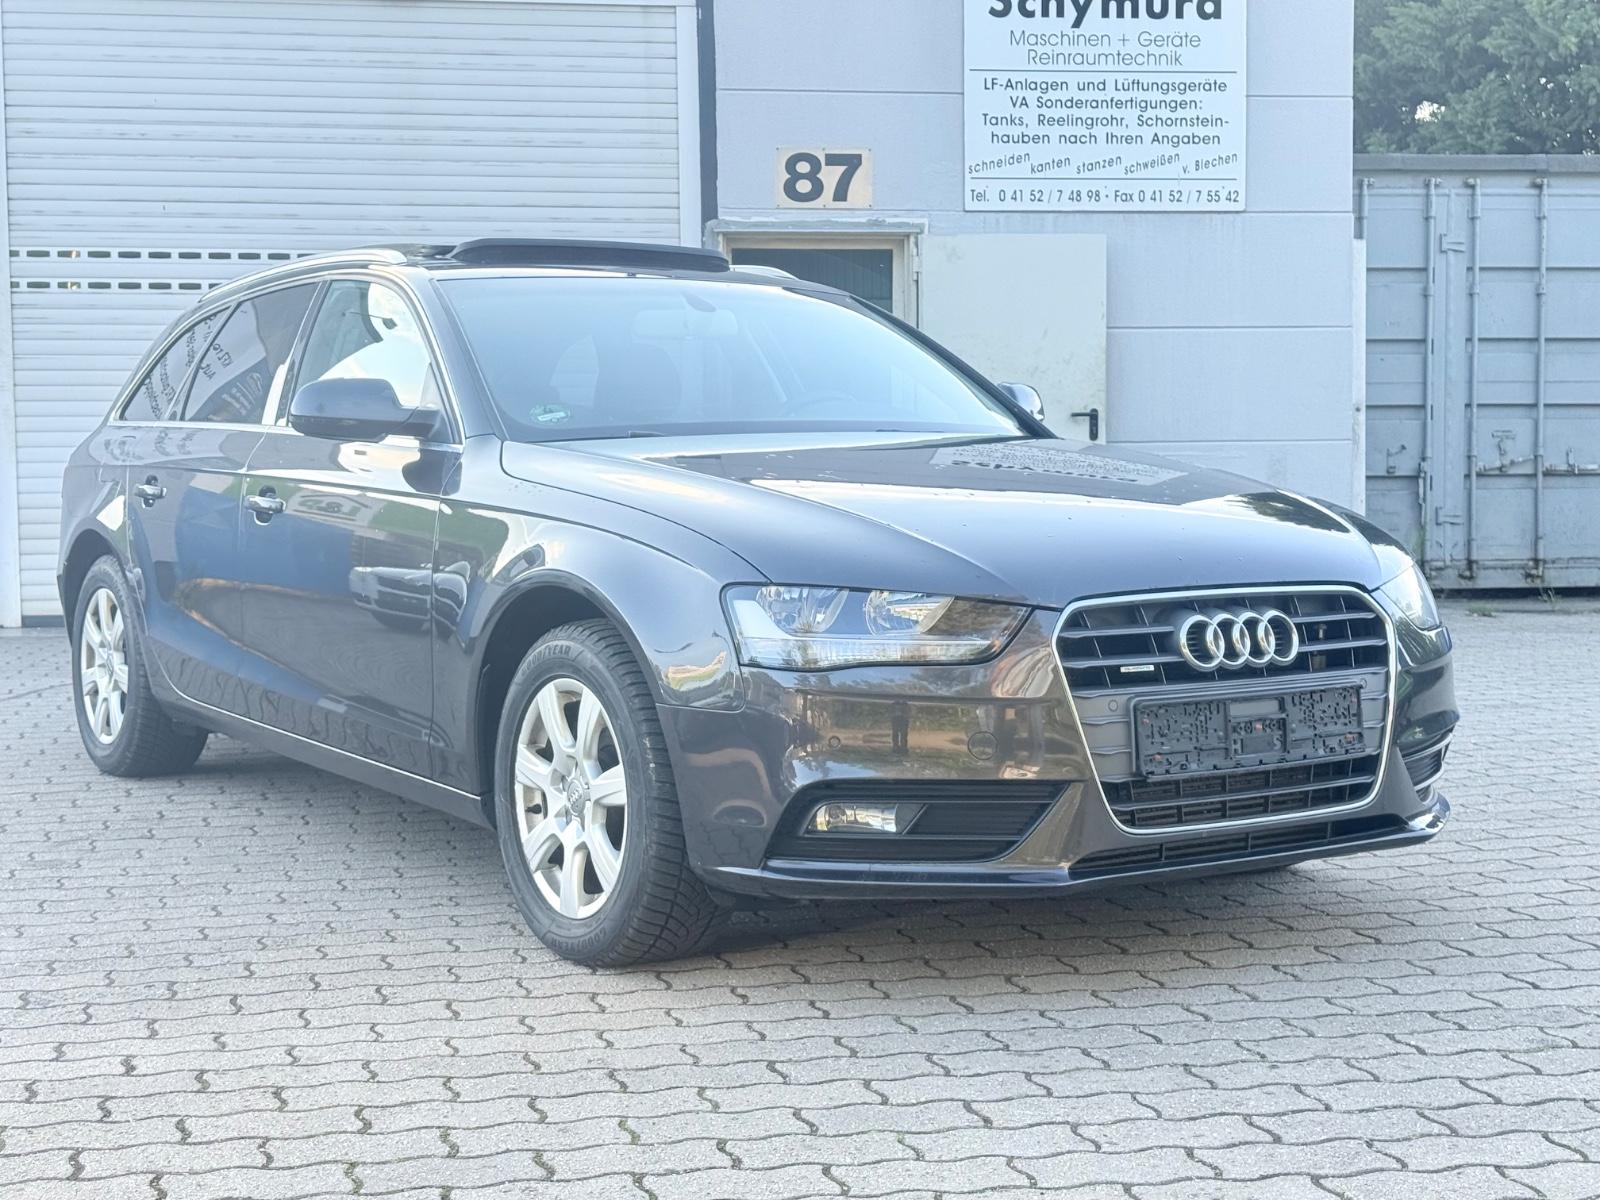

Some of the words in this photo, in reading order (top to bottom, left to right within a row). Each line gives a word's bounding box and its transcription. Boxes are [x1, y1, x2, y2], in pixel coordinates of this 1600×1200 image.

[1009, 29, 1111, 47] Maschinen
[1117, 34, 1130, 47] +
[1137, 31, 1202, 49] Geräte
[1027, 49, 1184, 67] Reinraumtechnik
[983, 77, 1069, 95] LF-Anlagen
[1076, 78, 1107, 92] und
[1114, 78, 1228, 95] Lüftungsgeräte
[1009, 96, 1030, 109] VA
[1036, 96, 1203, 112] Sonderanfertigungen:
[982, 113, 1029, 129] Tanks,
[1037, 114, 1129, 131] Reelingrohr,
[1136, 114, 1230, 128] Schornstein-
[990, 130, 1051, 145] hauben
[1058, 131, 1098, 145] nach
[1105, 131, 1144, 145] Ihren
[1150, 131, 1221, 148] Angaben
[968, 152, 1031, 175] schneiden
[1030, 156, 1071, 175] kanten
[1076, 155, 1122, 175] stanzen
[1124, 152, 1180, 176] schweißen
[1194, 152, 1238, 172] Blechen
[783, 152, 863, 203] 87
[970, 189, 990, 203] Tel.
[1114, 190, 1135, 203] Fax
